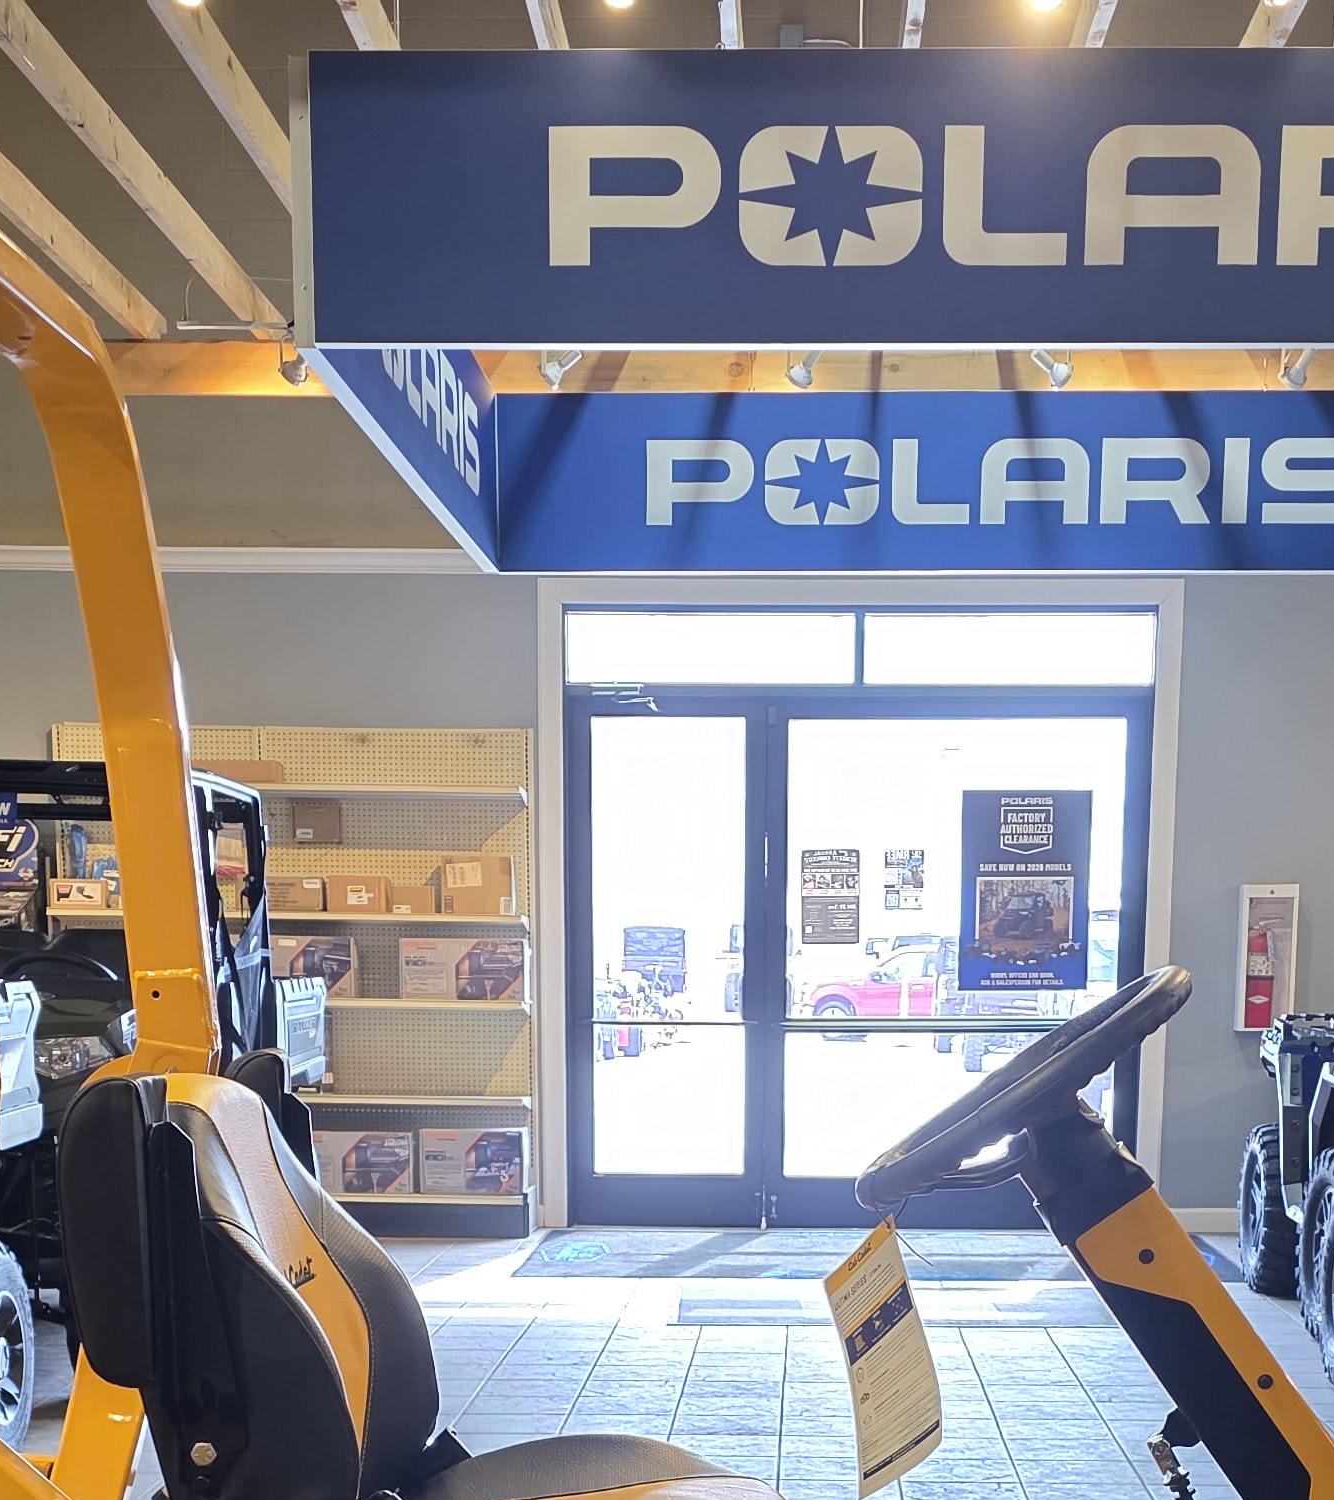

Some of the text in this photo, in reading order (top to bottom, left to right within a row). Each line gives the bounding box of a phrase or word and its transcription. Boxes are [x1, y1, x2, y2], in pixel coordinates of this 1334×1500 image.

[1000, 797, 1054, 805] POLARIS
[1007, 812, 1046, 824] FACTORY
[1000, 823, 1054, 834] AUTHORIZED
[1004, 834, 1049, 845] CLEARANCE
[979, 863, 998, 872] SAVE
[998, 863, 1015, 872] NOW
[1016, 863, 1026, 872] ON
[1045, 863, 1072, 872] MODELS
[289, 1256, 317, 1290] Cadet
[850, 1274, 867, 1296] SERIES
